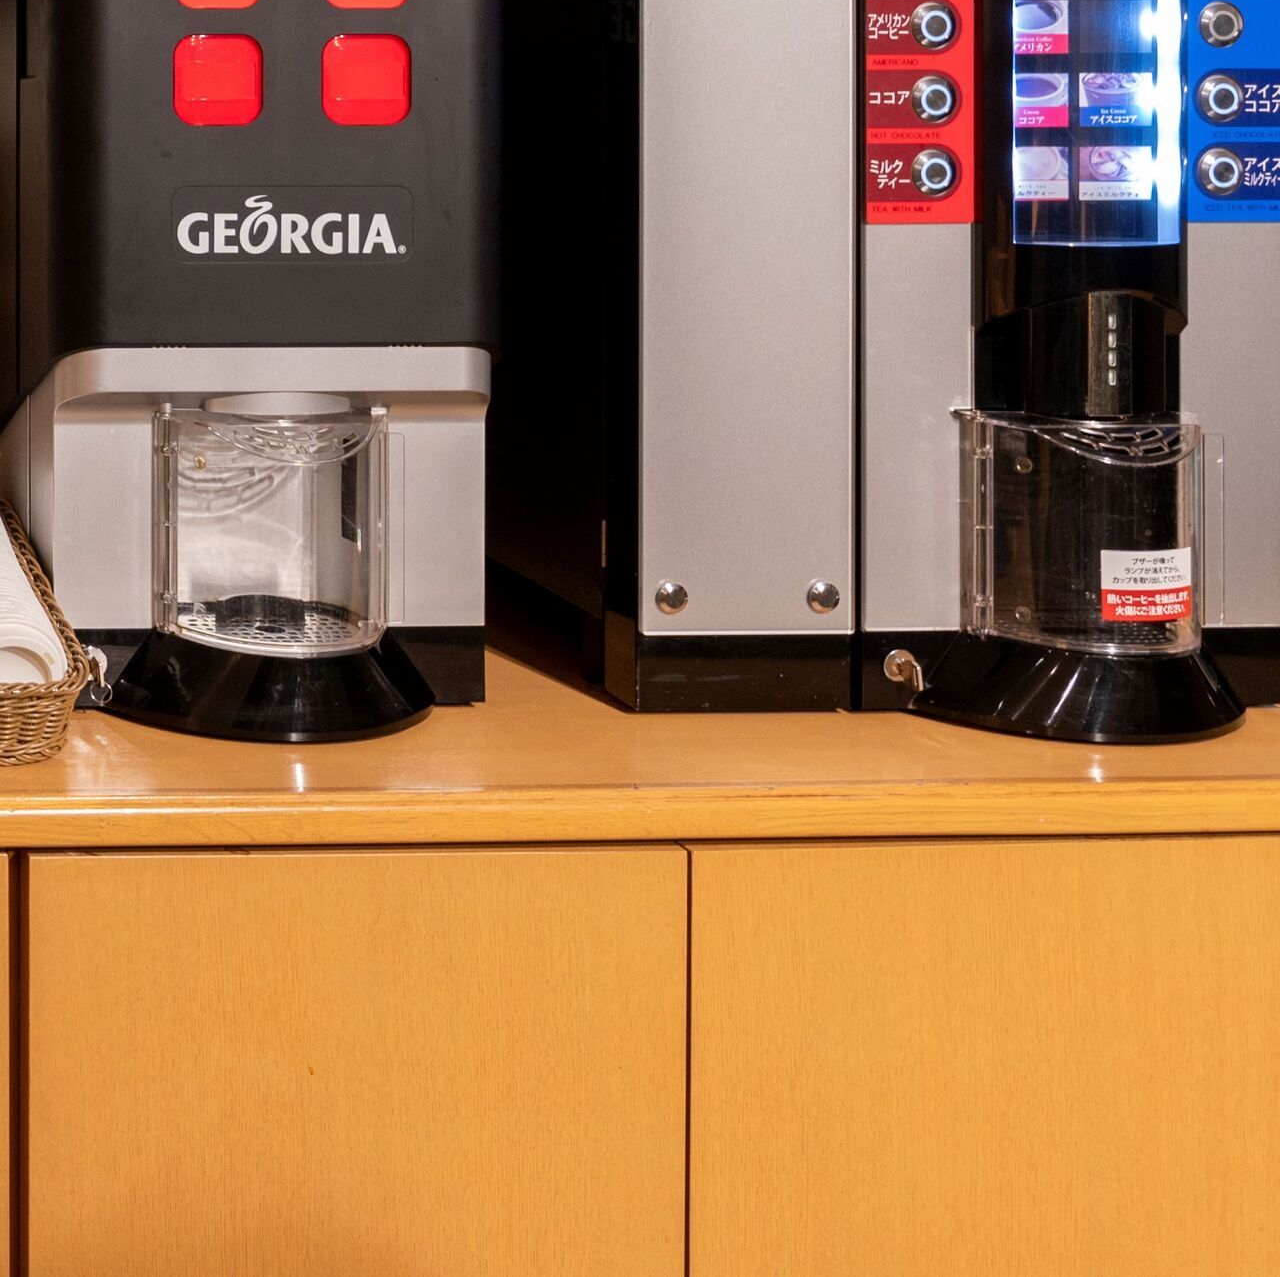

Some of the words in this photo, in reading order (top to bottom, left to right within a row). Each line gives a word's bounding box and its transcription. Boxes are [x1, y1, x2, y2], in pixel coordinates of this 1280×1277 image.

[868, 13, 911, 28] アメリカン
[868, 27, 909, 40] コーヒー
[868, 90, 911, 105] ココア
[1090, 115, 1138, 125] アイスココア
[869, 159, 904, 174] ミルク
[877, 175, 911, 189] ティー
[177, 194, 397, 255] GEORGIA
